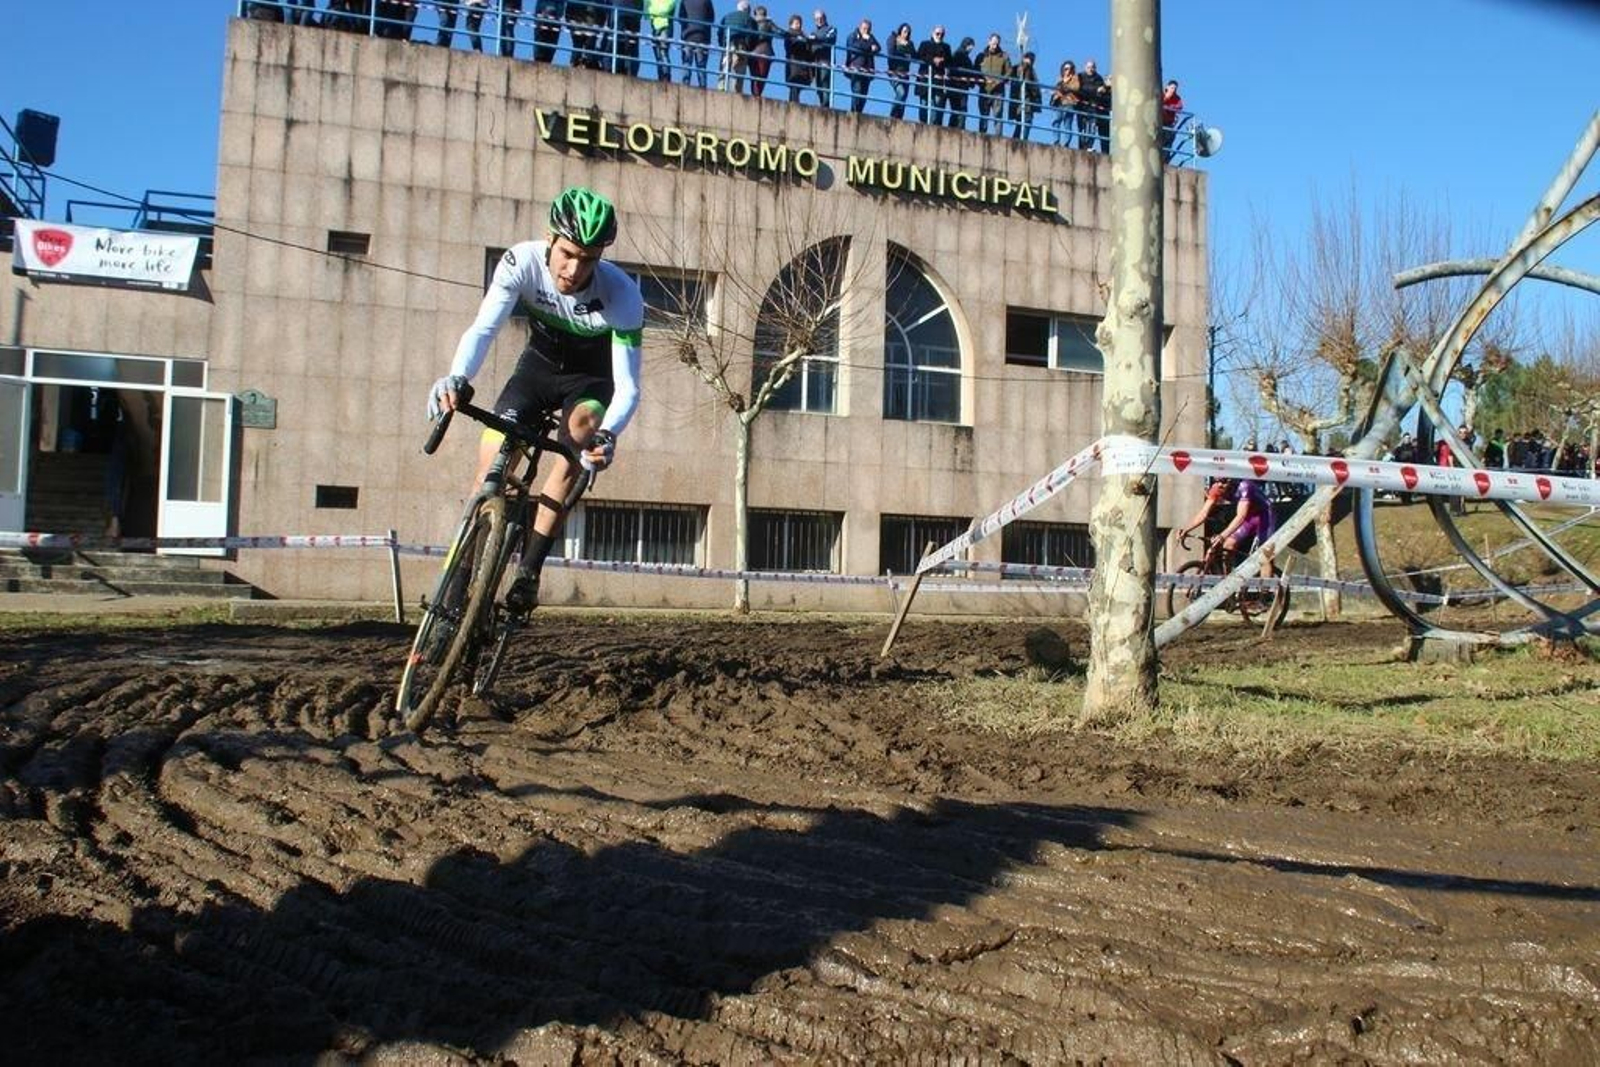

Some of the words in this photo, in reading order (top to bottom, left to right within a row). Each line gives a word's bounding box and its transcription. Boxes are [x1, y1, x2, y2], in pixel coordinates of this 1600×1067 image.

[534, 107, 820, 177] VELODROMO
[844, 154, 1059, 213] MUNICIPAL
[95, 237, 134, 254] More
[143, 244, 176, 257] bike
[99, 259, 135, 269] more
[145, 259, 171, 273] life
